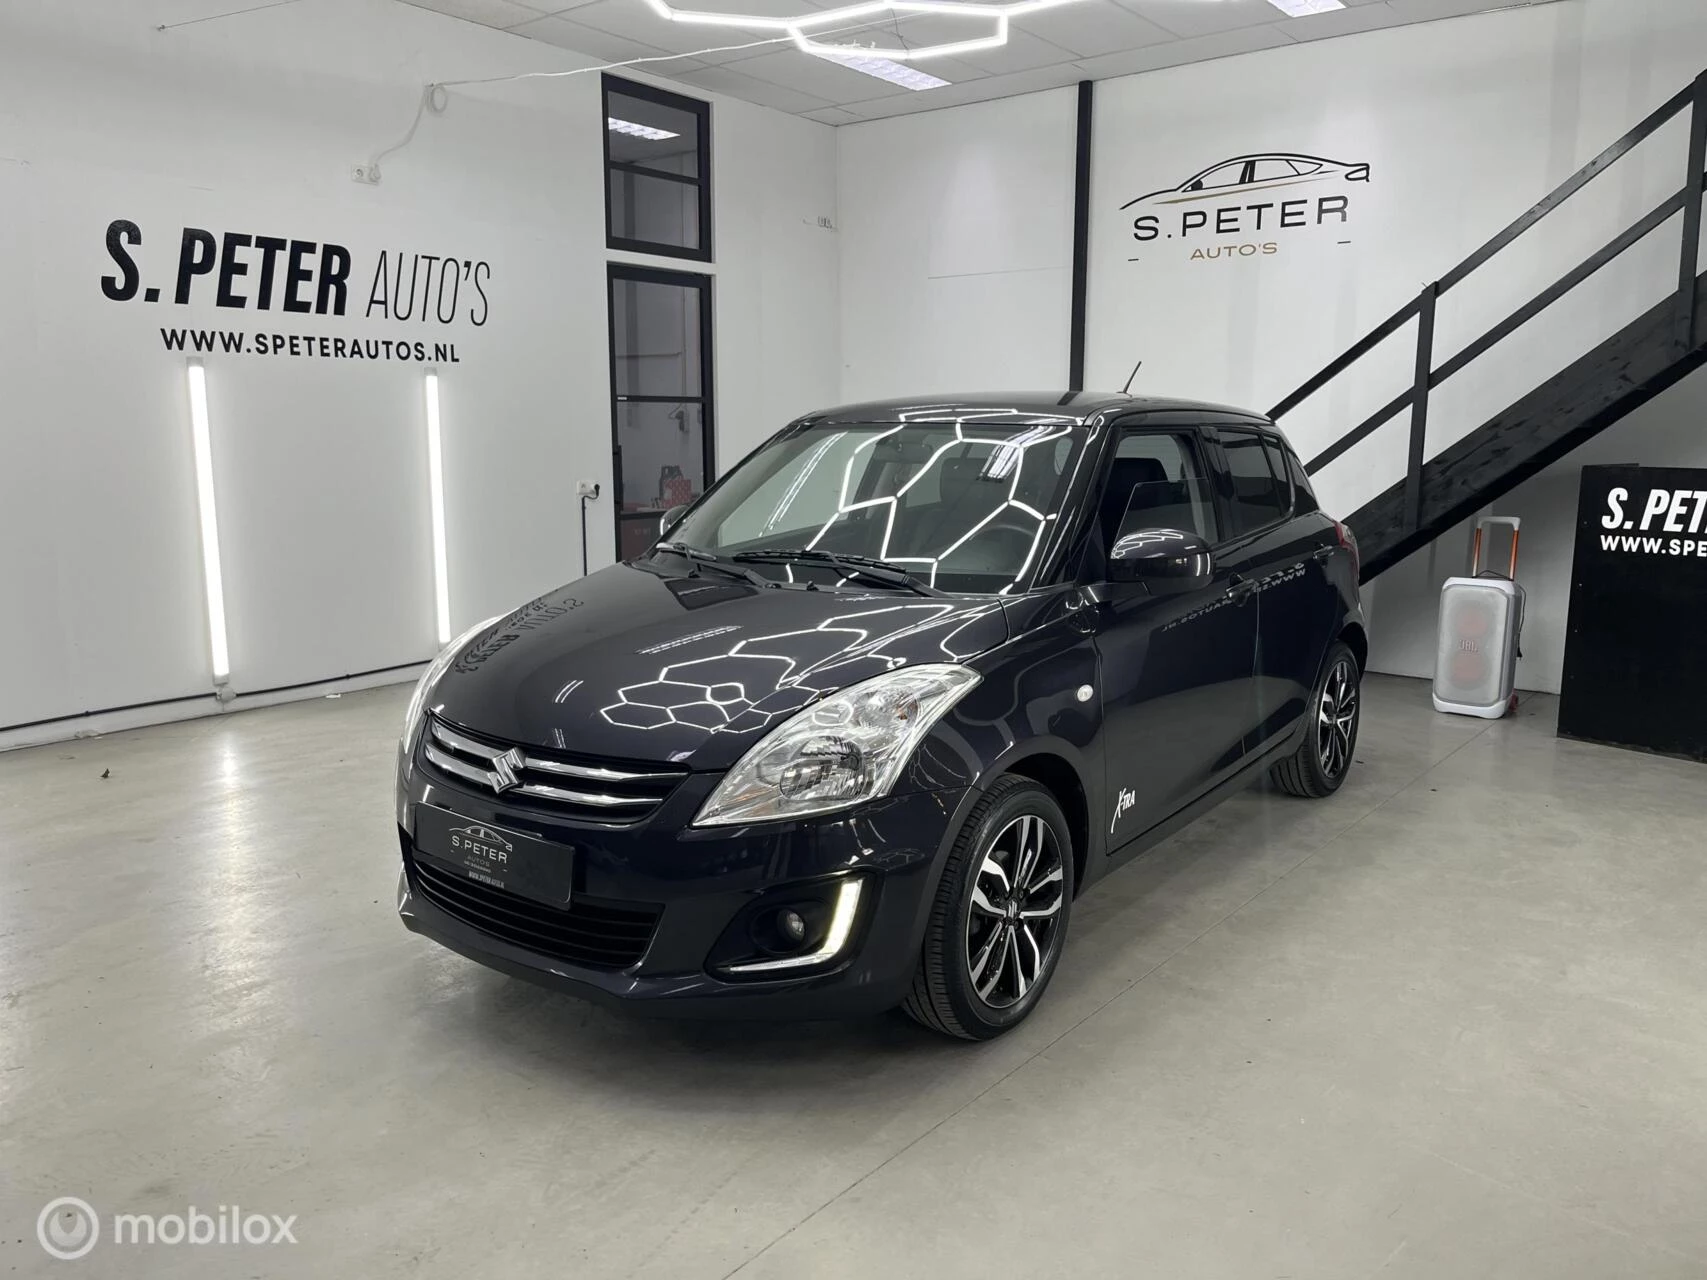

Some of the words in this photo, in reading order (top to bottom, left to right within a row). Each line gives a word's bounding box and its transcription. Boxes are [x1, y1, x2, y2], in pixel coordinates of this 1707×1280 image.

[1190, 242, 1278, 261] AUTO'S
[174, 227, 352, 316] PETER
[366, 250, 491, 327] AUTO'S
[160, 328, 460, 363] WWW.SPETERAUTOS.NL
[1639, 489, 1707, 534] PET
[1600, 535, 1707, 557] WWW.SPE
